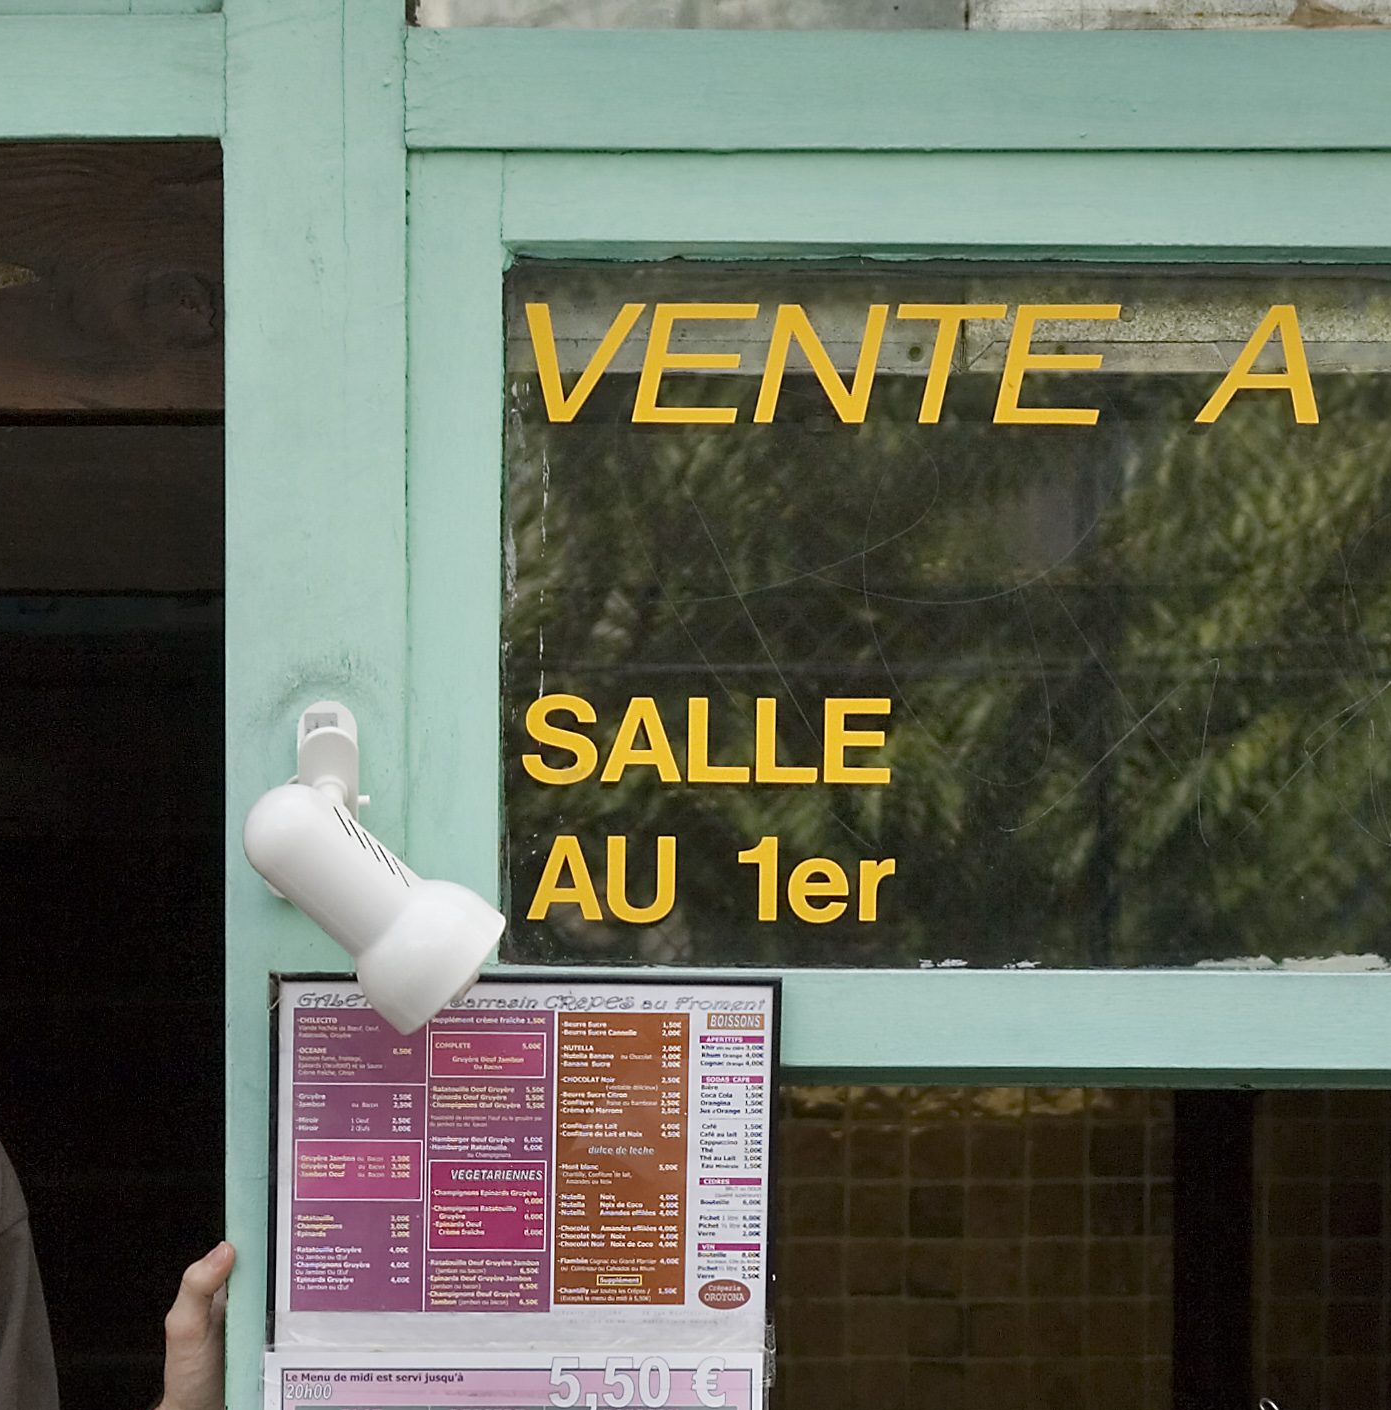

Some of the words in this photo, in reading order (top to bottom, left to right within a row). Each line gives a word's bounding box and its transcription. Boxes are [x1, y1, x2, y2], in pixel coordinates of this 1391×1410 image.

[525, 303, 1121, 424] VENTE
[1197, 304, 1318, 424] A
[523, 695, 891, 785] SALLE
[527, 835, 677, 923] AU
[738, 836, 896, 924] 1er
[709, 1014, 762, 1028] BOISSONS
[588, 1145, 613, 1155] dulce
[615, 1145, 627, 1155] de
[450, 1169, 543, 1181] VEGETARIENNES
[285, 1373, 298, 1382] Le
[301, 1373, 330, 1382] Menu
[333, 1373, 347, 1382] de
[350, 1373, 374, 1382] midi
[376, 1374, 392, 1383] est
[395, 1373, 422, 1383] servi
[423, 1373, 464, 1384] jusqu'à
[690, 1355, 727, 1409] €
[285, 1384, 332, 1400] 20h00
